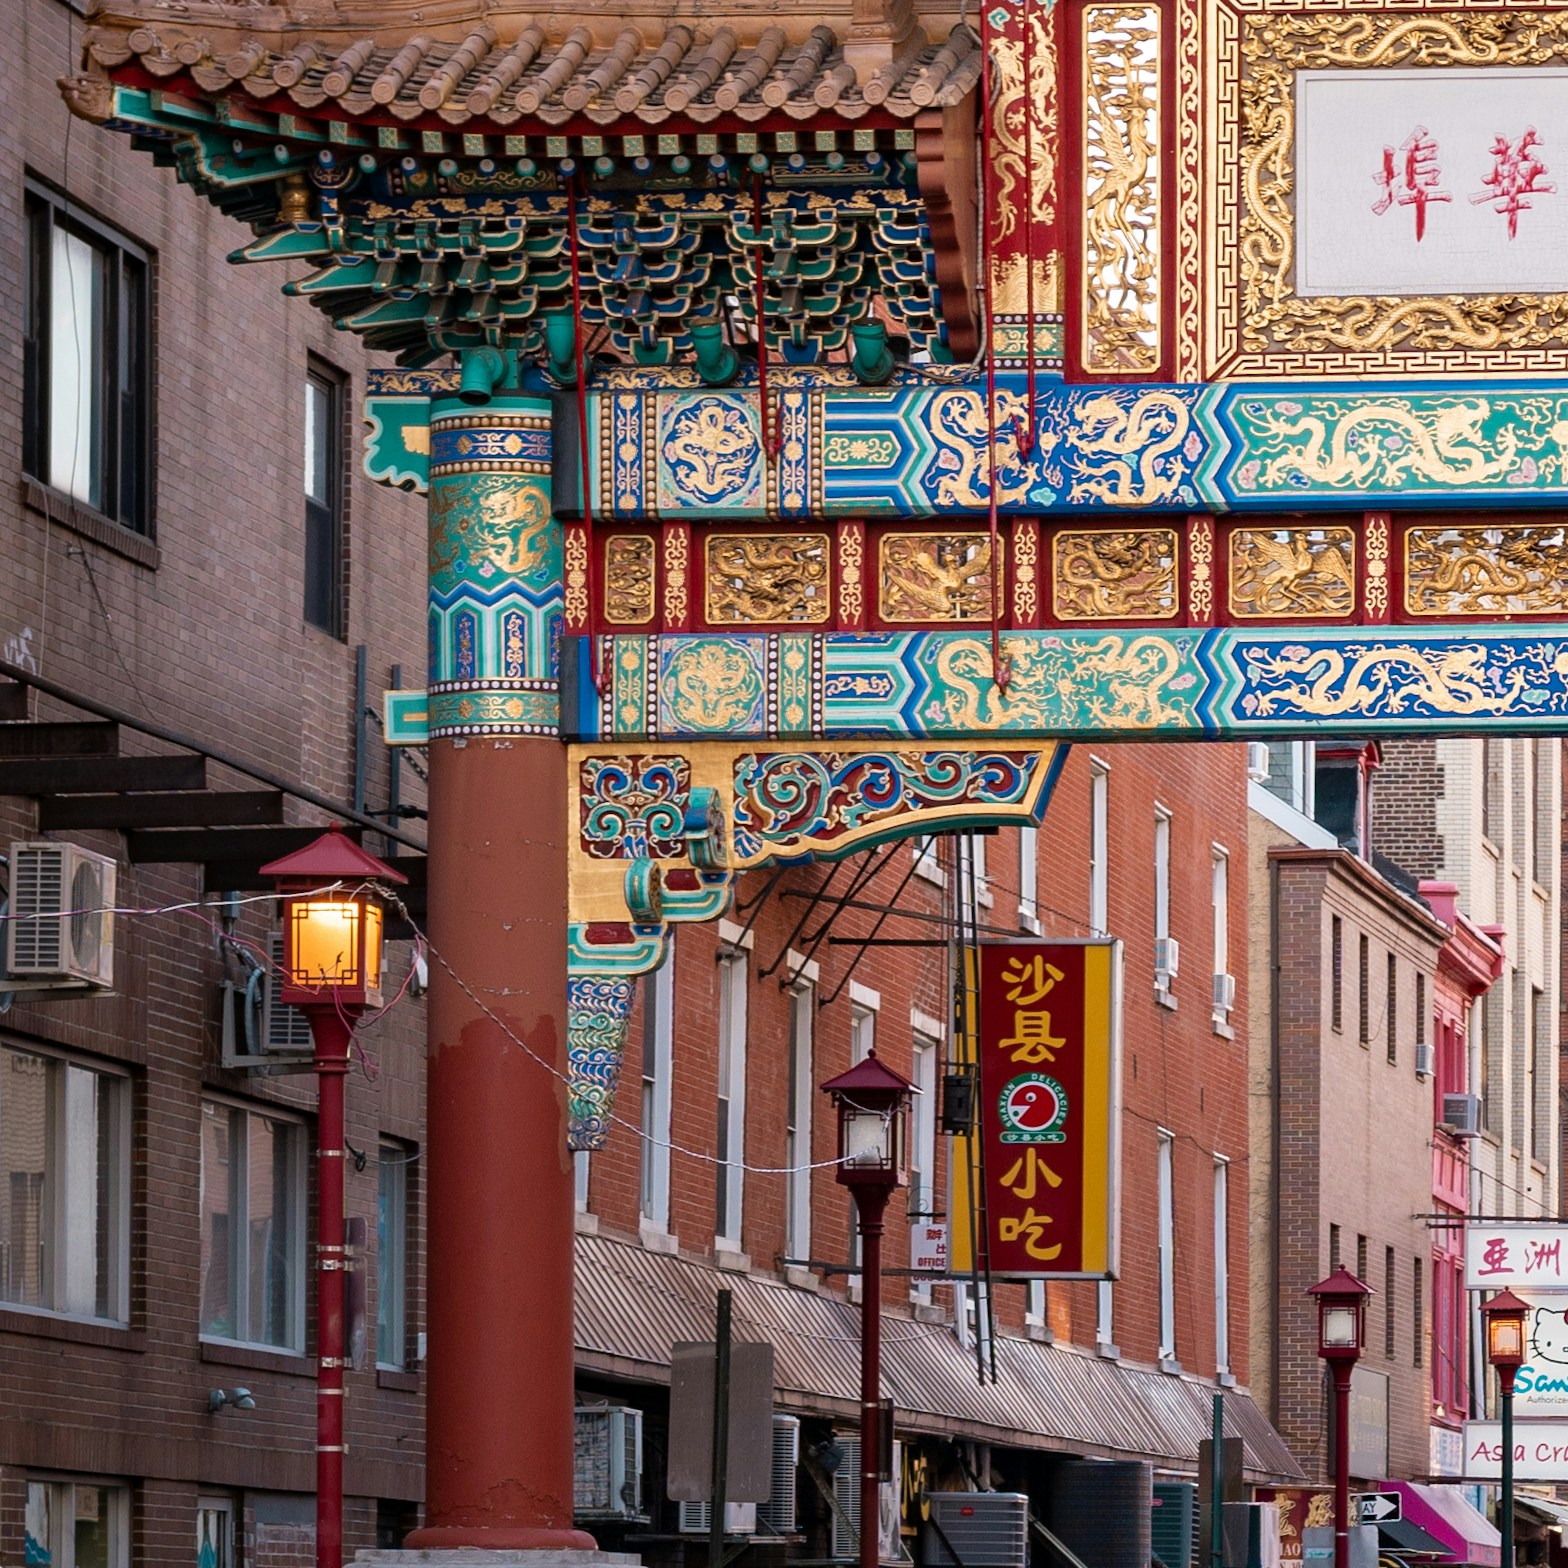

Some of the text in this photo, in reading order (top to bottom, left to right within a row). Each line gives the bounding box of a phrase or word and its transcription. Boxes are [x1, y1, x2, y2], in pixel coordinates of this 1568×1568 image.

[1000, 1072, 1069, 1128] SHAXIAN DELICACIES
[917, 1257, 946, 1268] OFFICE
[1471, 1440, 1525, 1464] Asa
